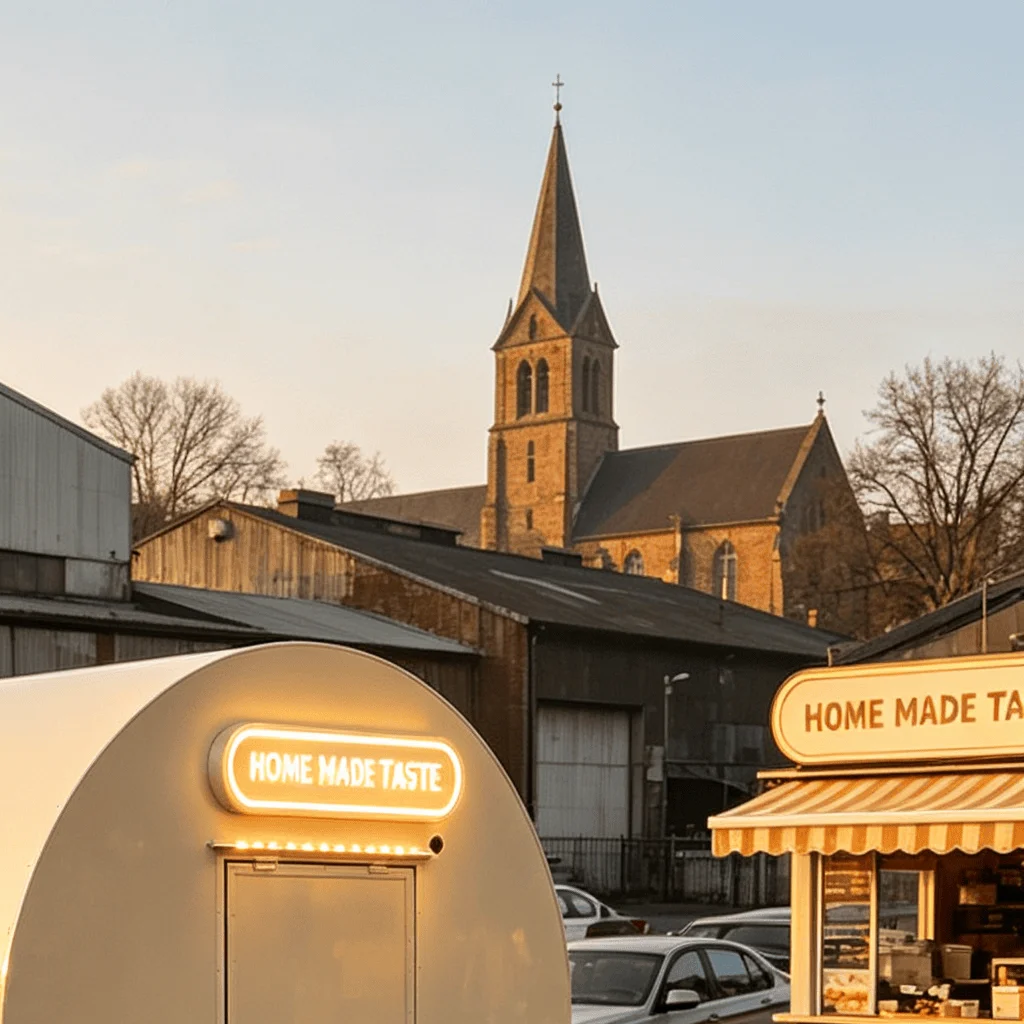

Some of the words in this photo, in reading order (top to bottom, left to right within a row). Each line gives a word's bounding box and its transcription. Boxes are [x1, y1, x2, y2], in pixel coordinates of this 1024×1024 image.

[804, 699, 884, 732] HOME
[894, 692, 977, 727] MADE
[249, 751, 313, 785] HOME
[317, 754, 375, 788] MADE
[378, 758, 443, 792] TASTE
